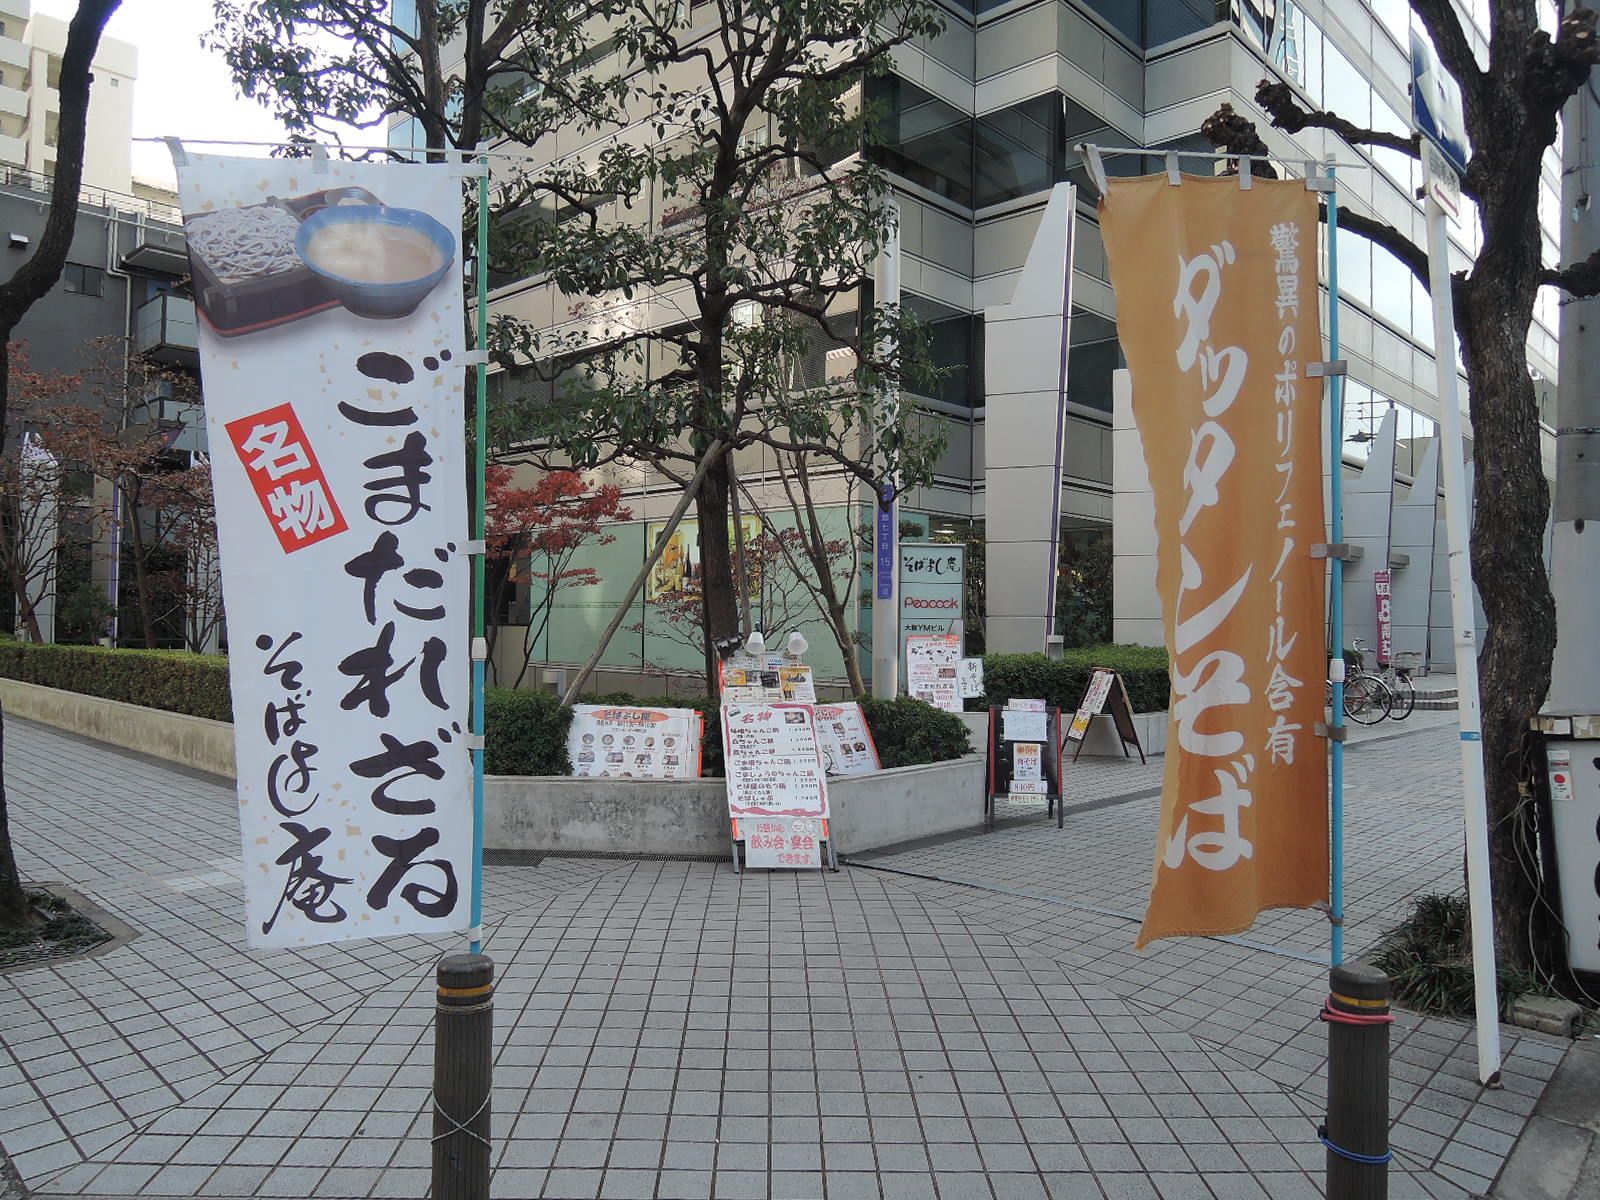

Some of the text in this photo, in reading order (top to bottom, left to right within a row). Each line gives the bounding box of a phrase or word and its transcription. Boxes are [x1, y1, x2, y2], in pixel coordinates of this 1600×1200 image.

[240, 418, 339, 540] 名物
[903, 556, 960, 575] そばよし庵
[904, 596, 958, 609] Peacock
[1163, 240, 1254, 871] ダッタンそば
[1264, 222, 1303, 765] 驚異のポリフェノール含有
[255, 632, 355, 935] そばよし庵
[337, 349, 460, 918] ごまだれざる
